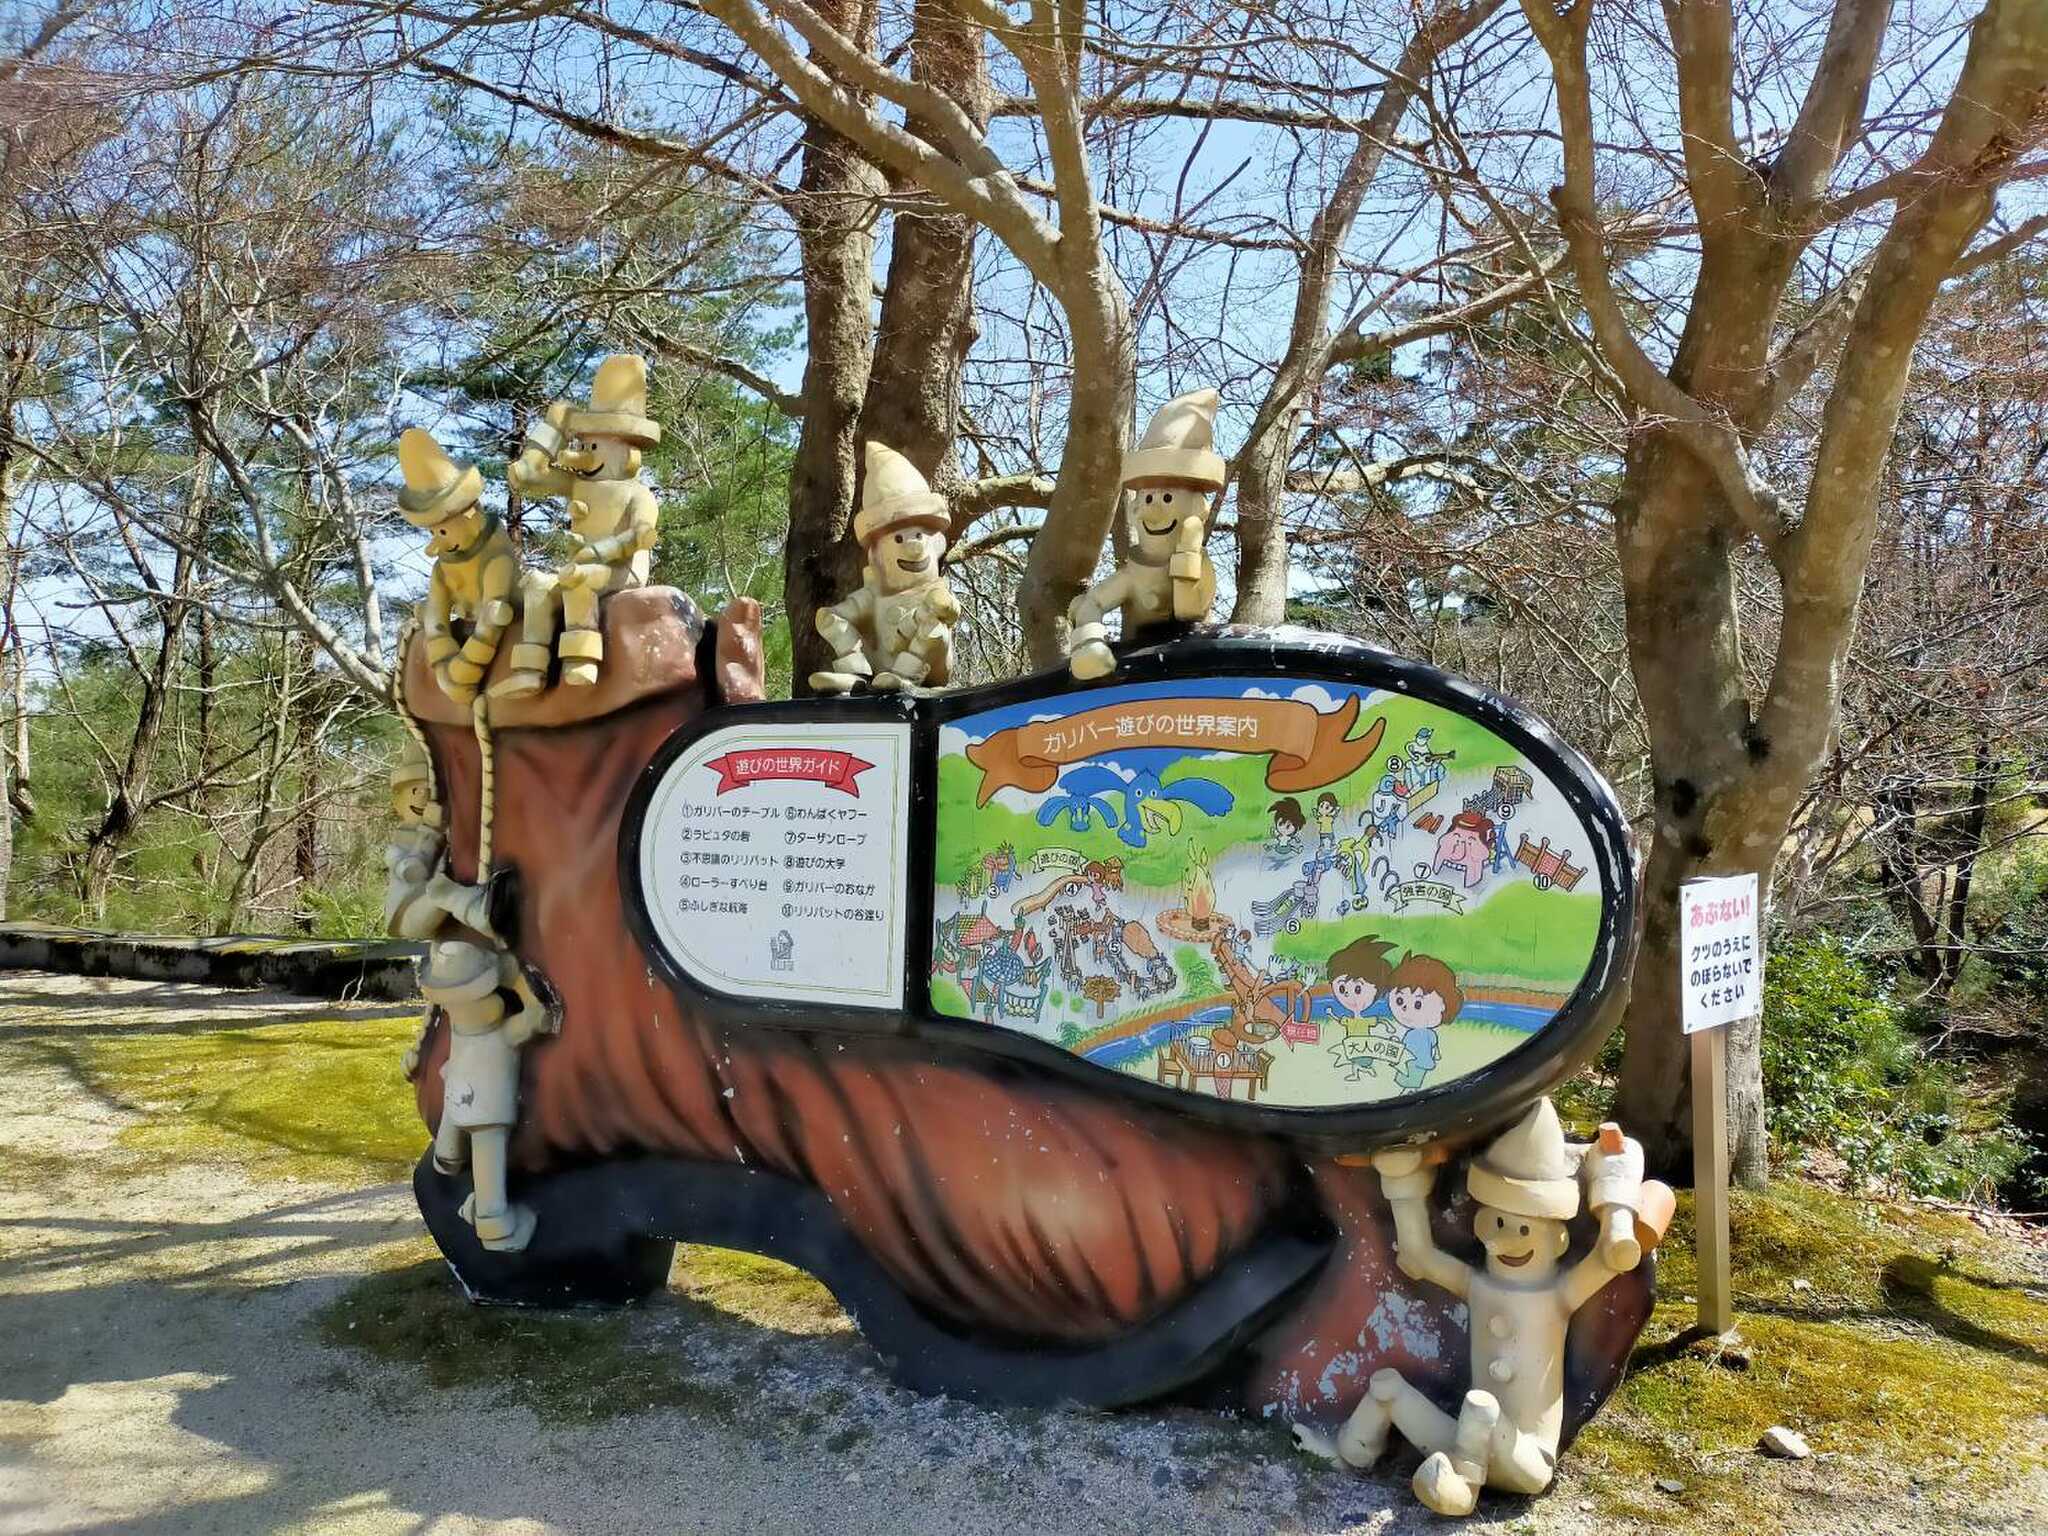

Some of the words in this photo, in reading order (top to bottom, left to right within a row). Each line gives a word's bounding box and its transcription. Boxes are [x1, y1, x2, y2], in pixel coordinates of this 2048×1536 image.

[1043, 714, 1258, 754] ガリバー遊びの世界案内
[736, 757, 841, 775] 遊びの世界ガイド
[1692, 936, 1750, 962] クツのうえに
[1691, 958, 1752, 986] のぼらないで
[1701, 984, 1744, 1008] ください
